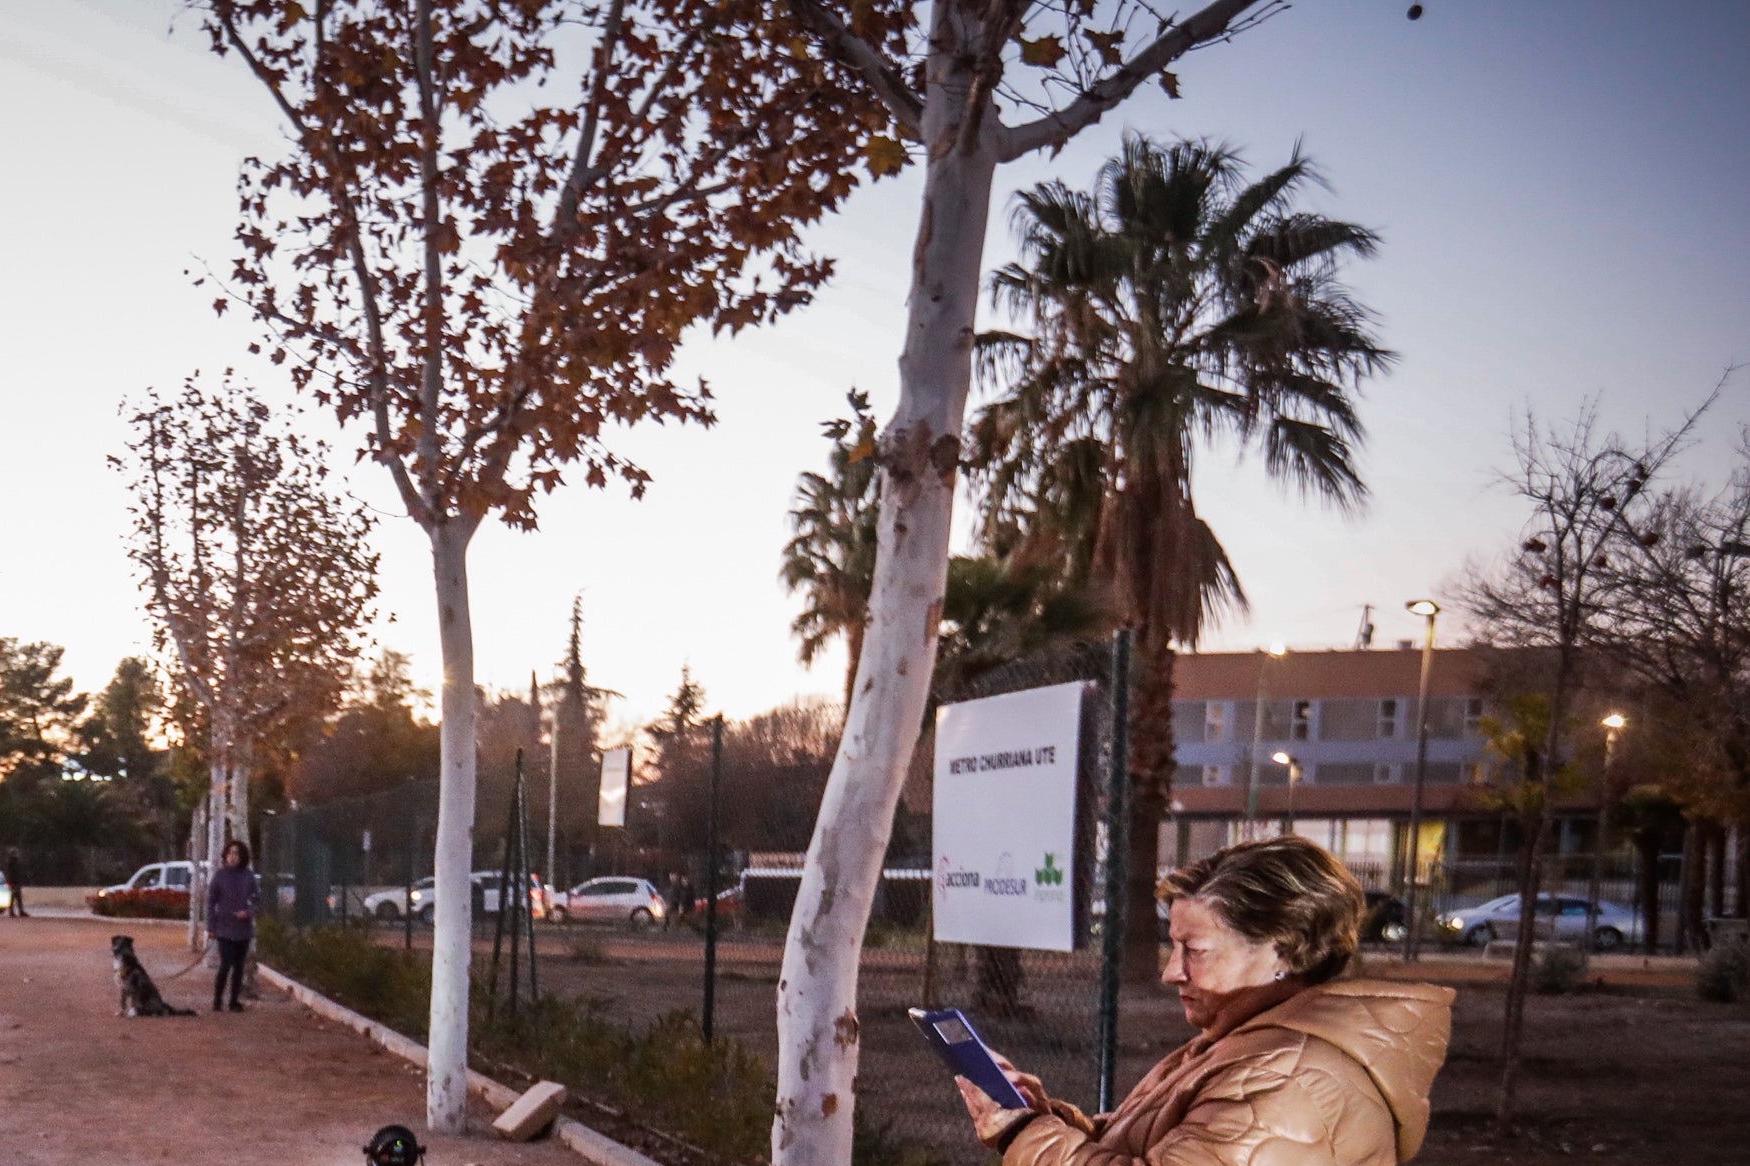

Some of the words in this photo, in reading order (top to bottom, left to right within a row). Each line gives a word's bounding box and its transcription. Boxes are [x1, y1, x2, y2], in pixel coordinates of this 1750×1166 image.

[950, 756, 978, 775] METRO
[980, 749, 1033, 773] CHURRIANA
[1035, 746, 1056, 765] UTE
[946, 865, 980, 888] acciona
